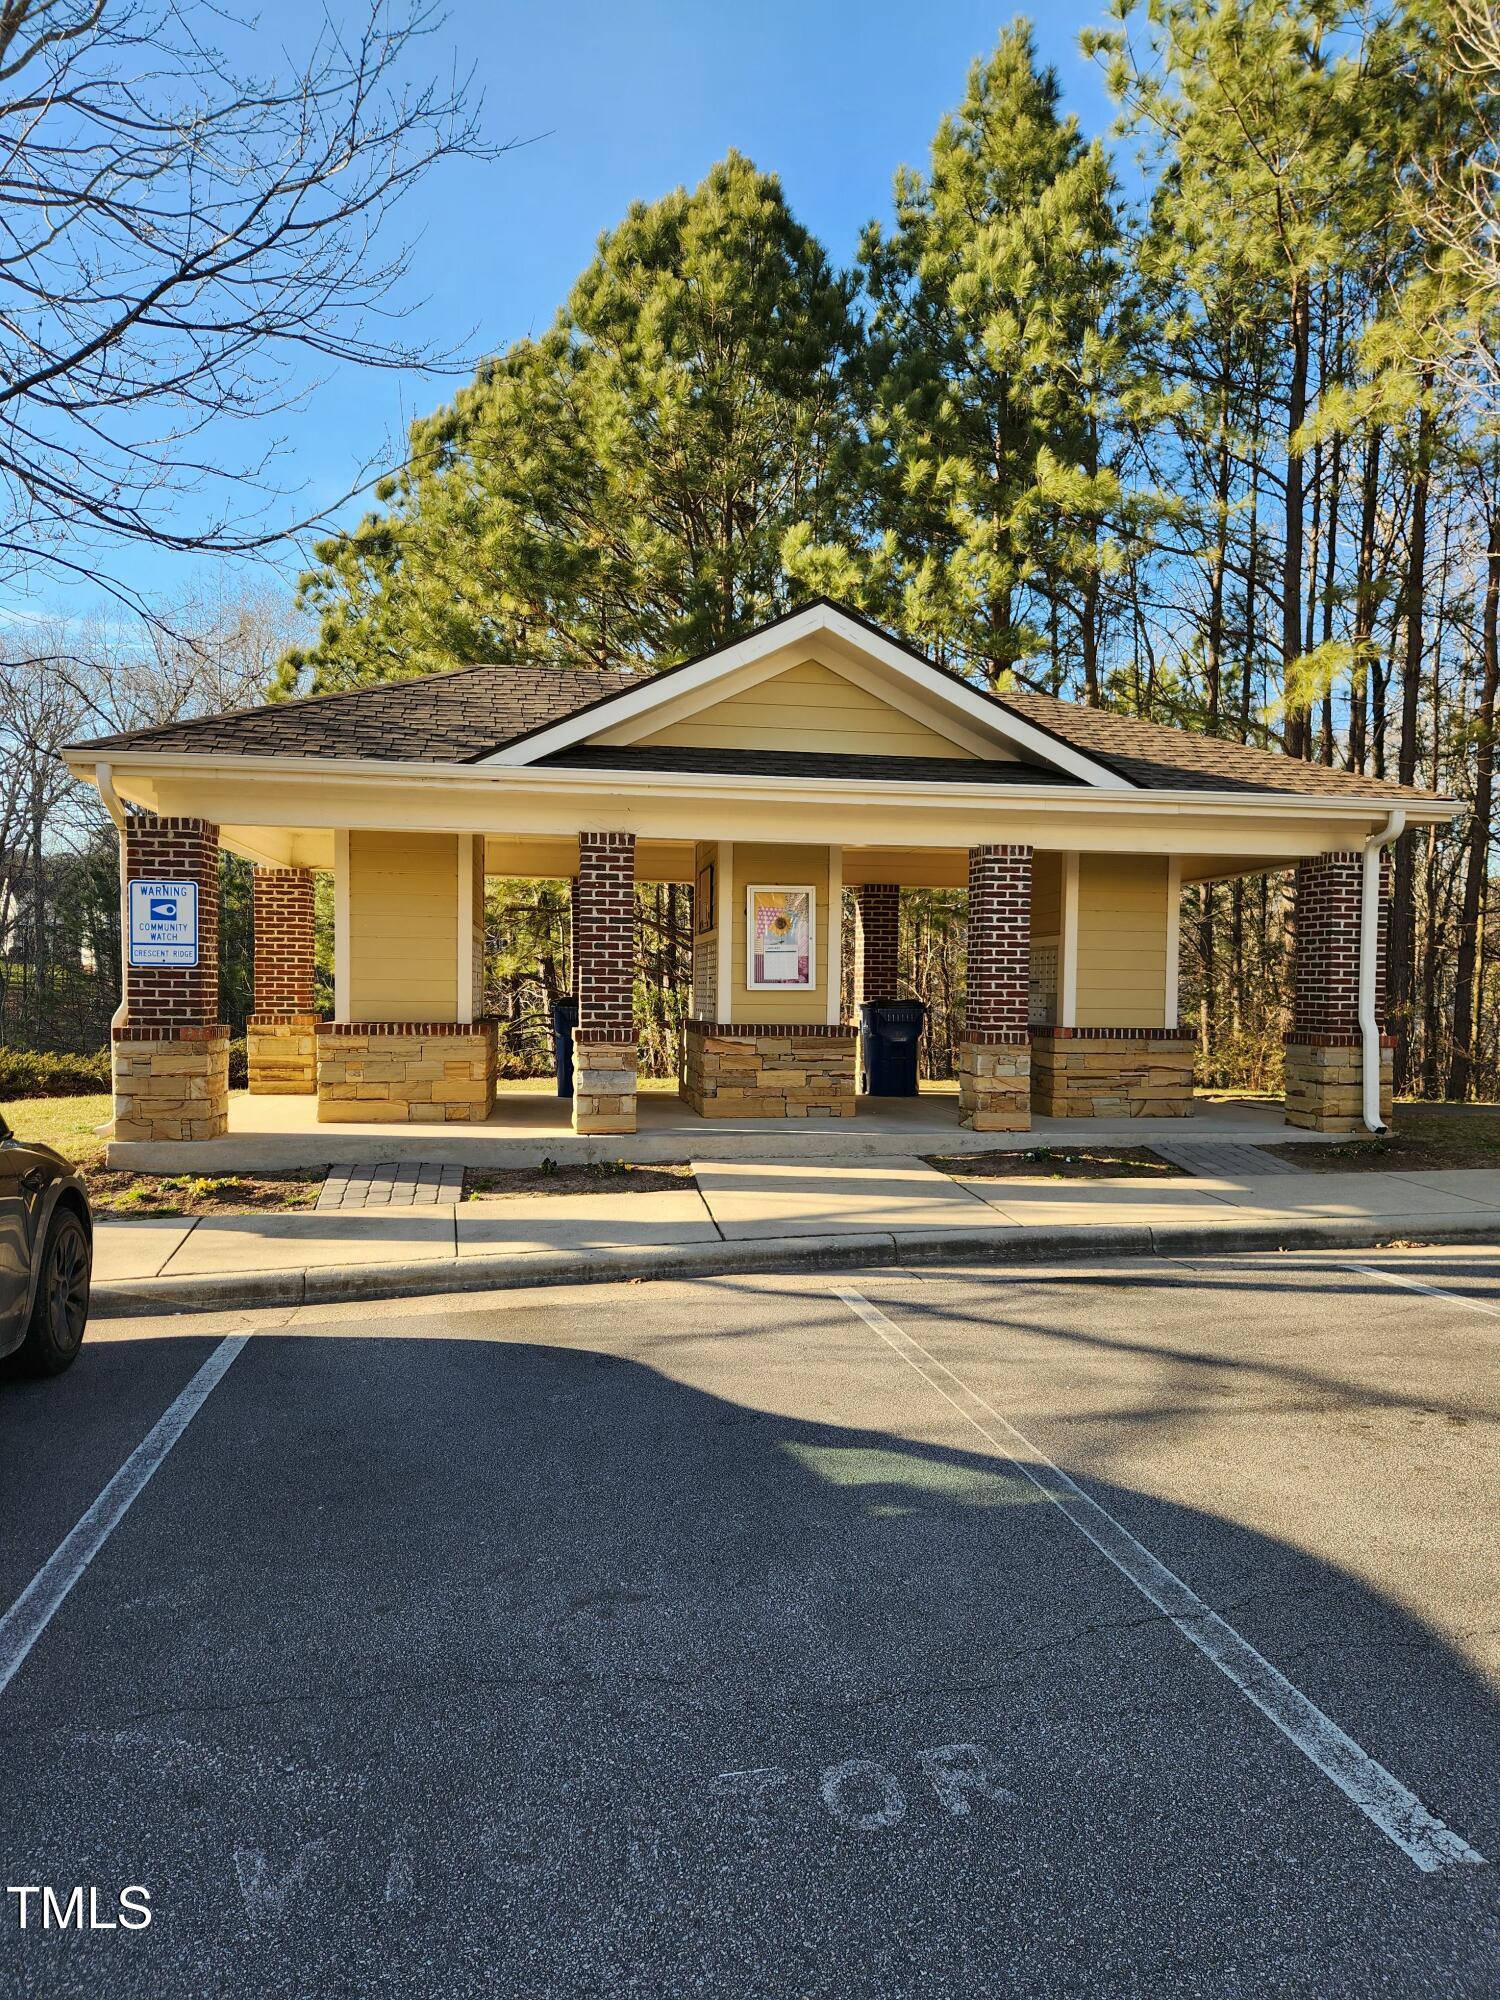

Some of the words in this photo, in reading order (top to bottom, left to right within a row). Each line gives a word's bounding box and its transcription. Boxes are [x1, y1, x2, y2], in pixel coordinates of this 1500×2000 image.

[140, 886, 187, 897] WARNING
[139, 922, 188, 932] COMMUNITY
[150, 933, 178, 941] WATCH
[134, 949, 169, 957] CRESCENT
[173, 950, 193, 958] RIDGE
